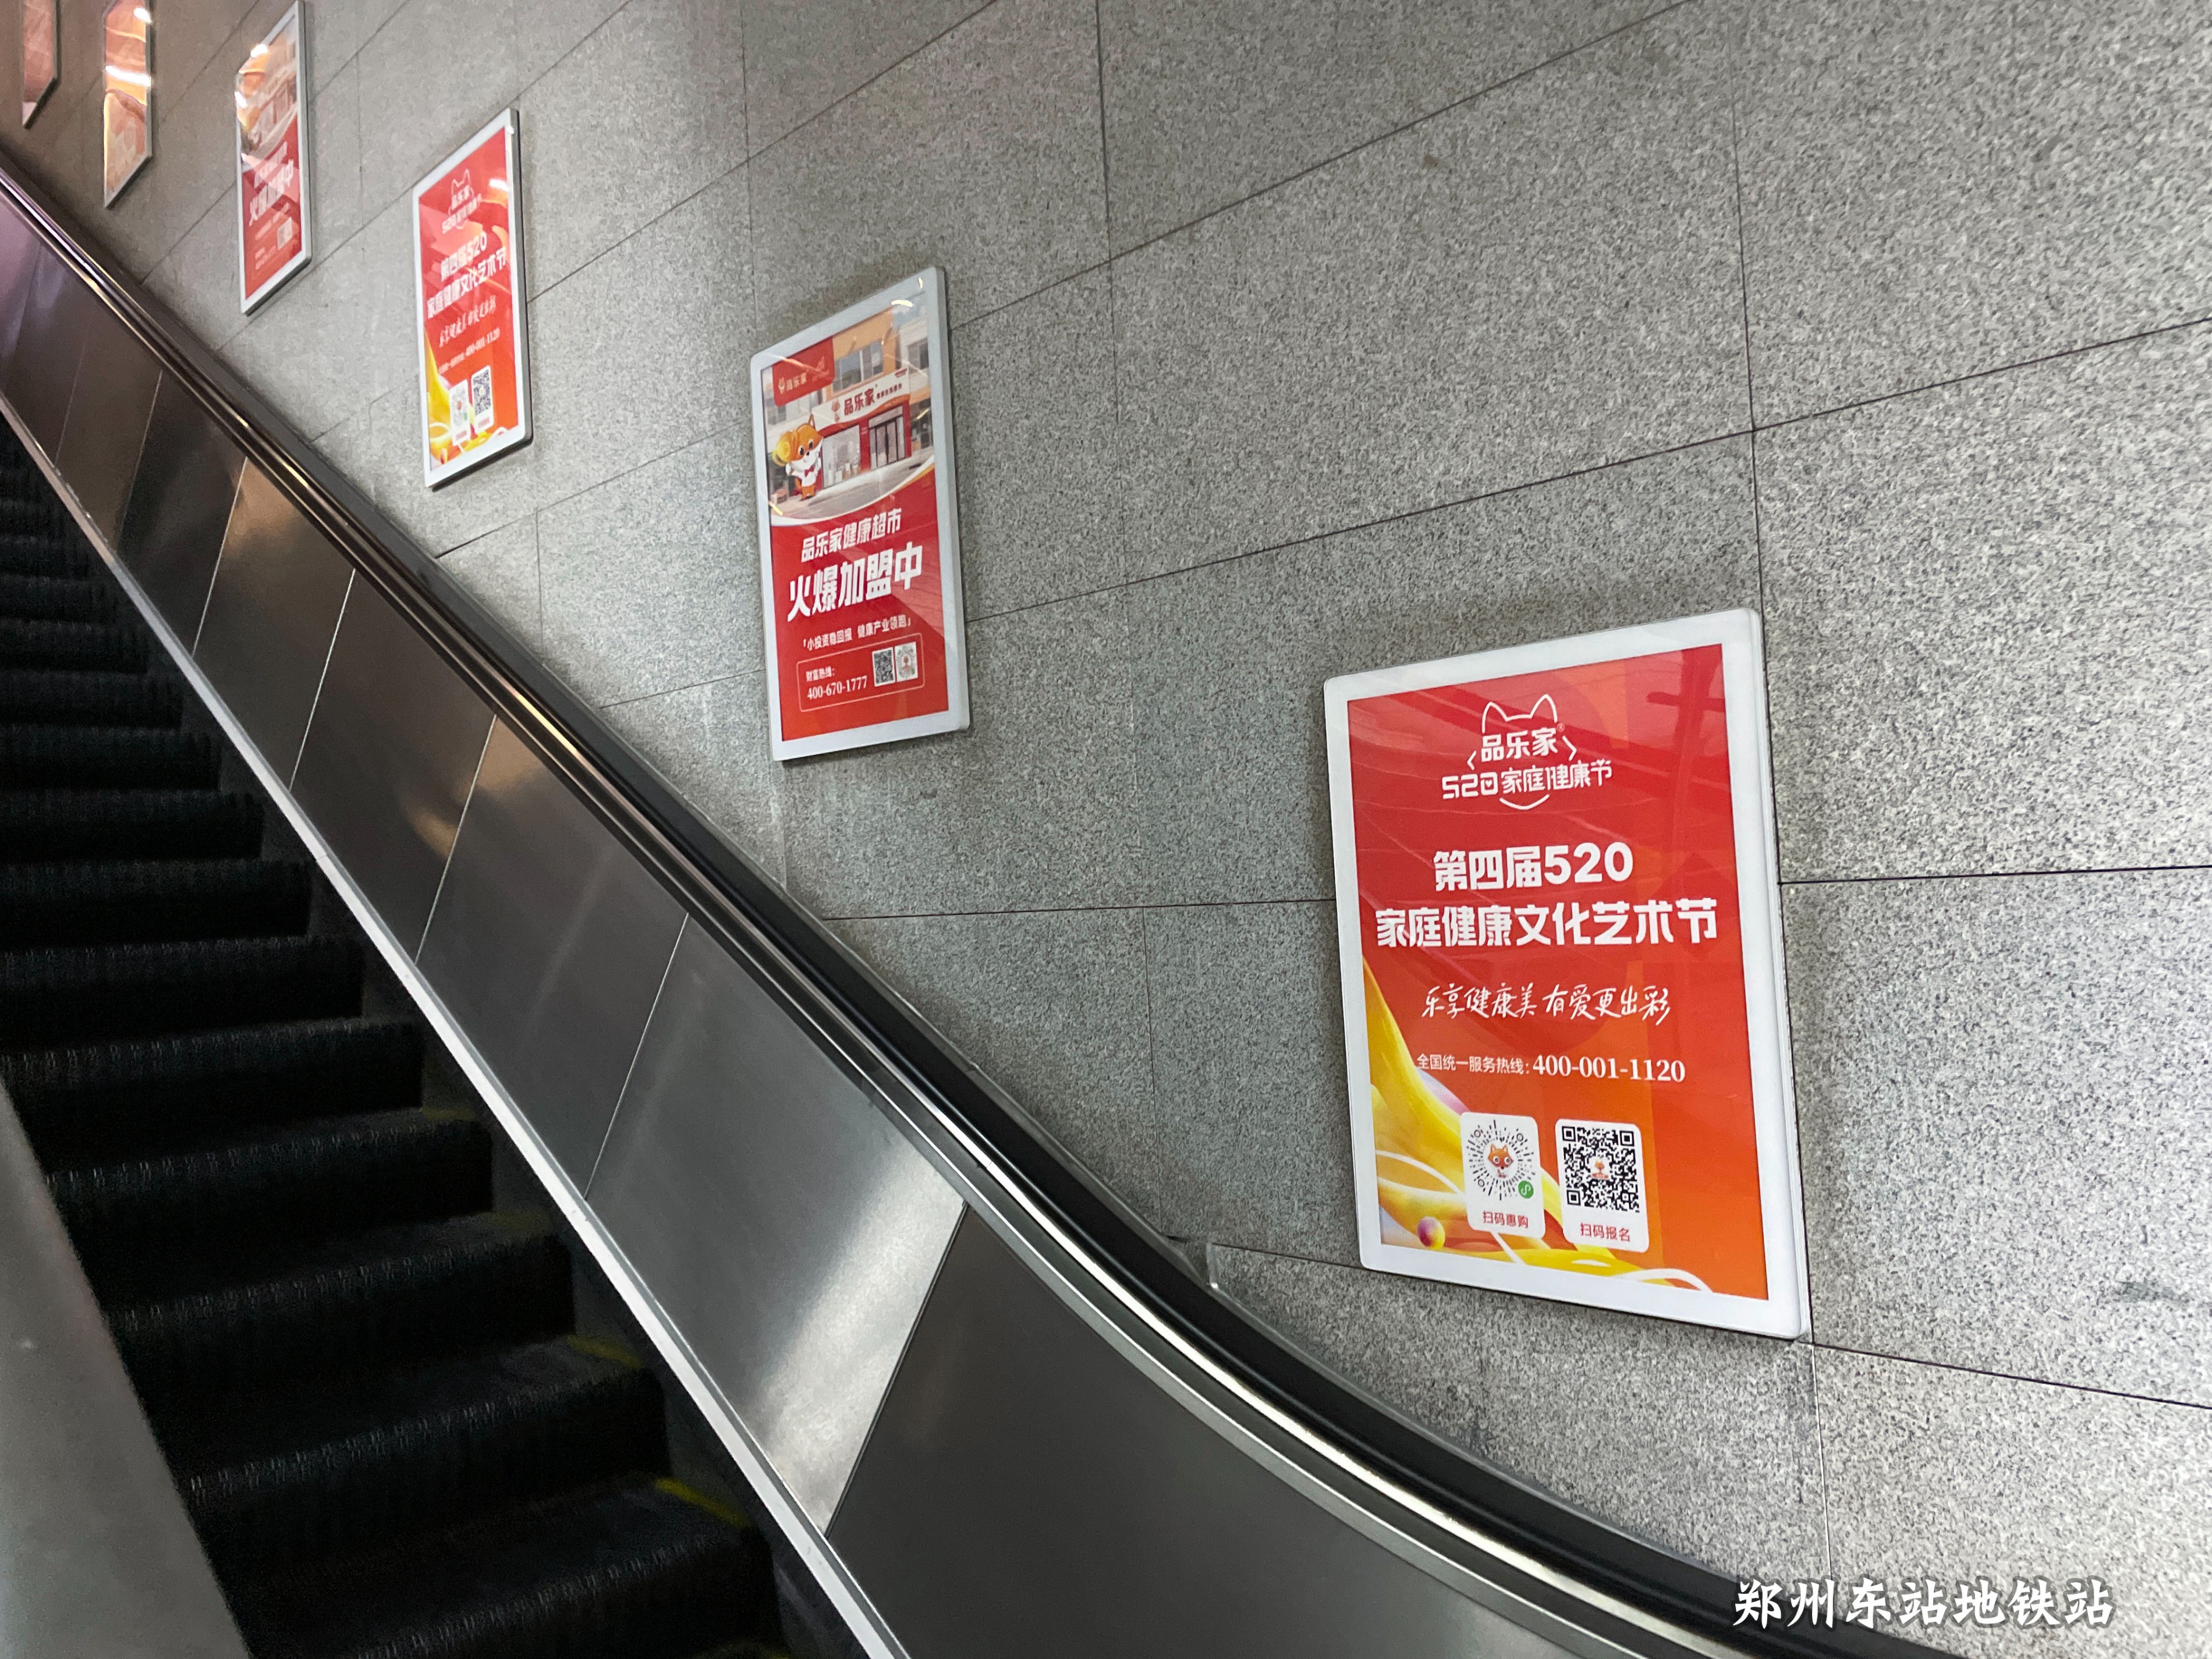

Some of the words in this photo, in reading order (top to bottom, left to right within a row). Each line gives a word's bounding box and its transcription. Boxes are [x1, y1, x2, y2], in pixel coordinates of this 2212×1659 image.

[844, 388, 875, 416] 品乐家
[802, 508, 902, 562] 品乐家健康超市
[788, 541, 923, 622] 火爆加盟中
[807, 675, 867, 700] 400-670-1777
[1481, 727, 1558, 762] 品乐家
[1433, 842, 1633, 891] 第四届520
[1376, 898, 1717, 948] 家庭健康文化艺术节
[1422, 982, 1537, 1019] 乐享健康美
[1543, 984, 1671, 1026] 有爱更出彩
[1533, 1054, 1685, 1082] 400-001-1120
[1483, 1211, 1529, 1229] 扫码惠购
[1580, 1222, 1630, 1242] 扫码报名
